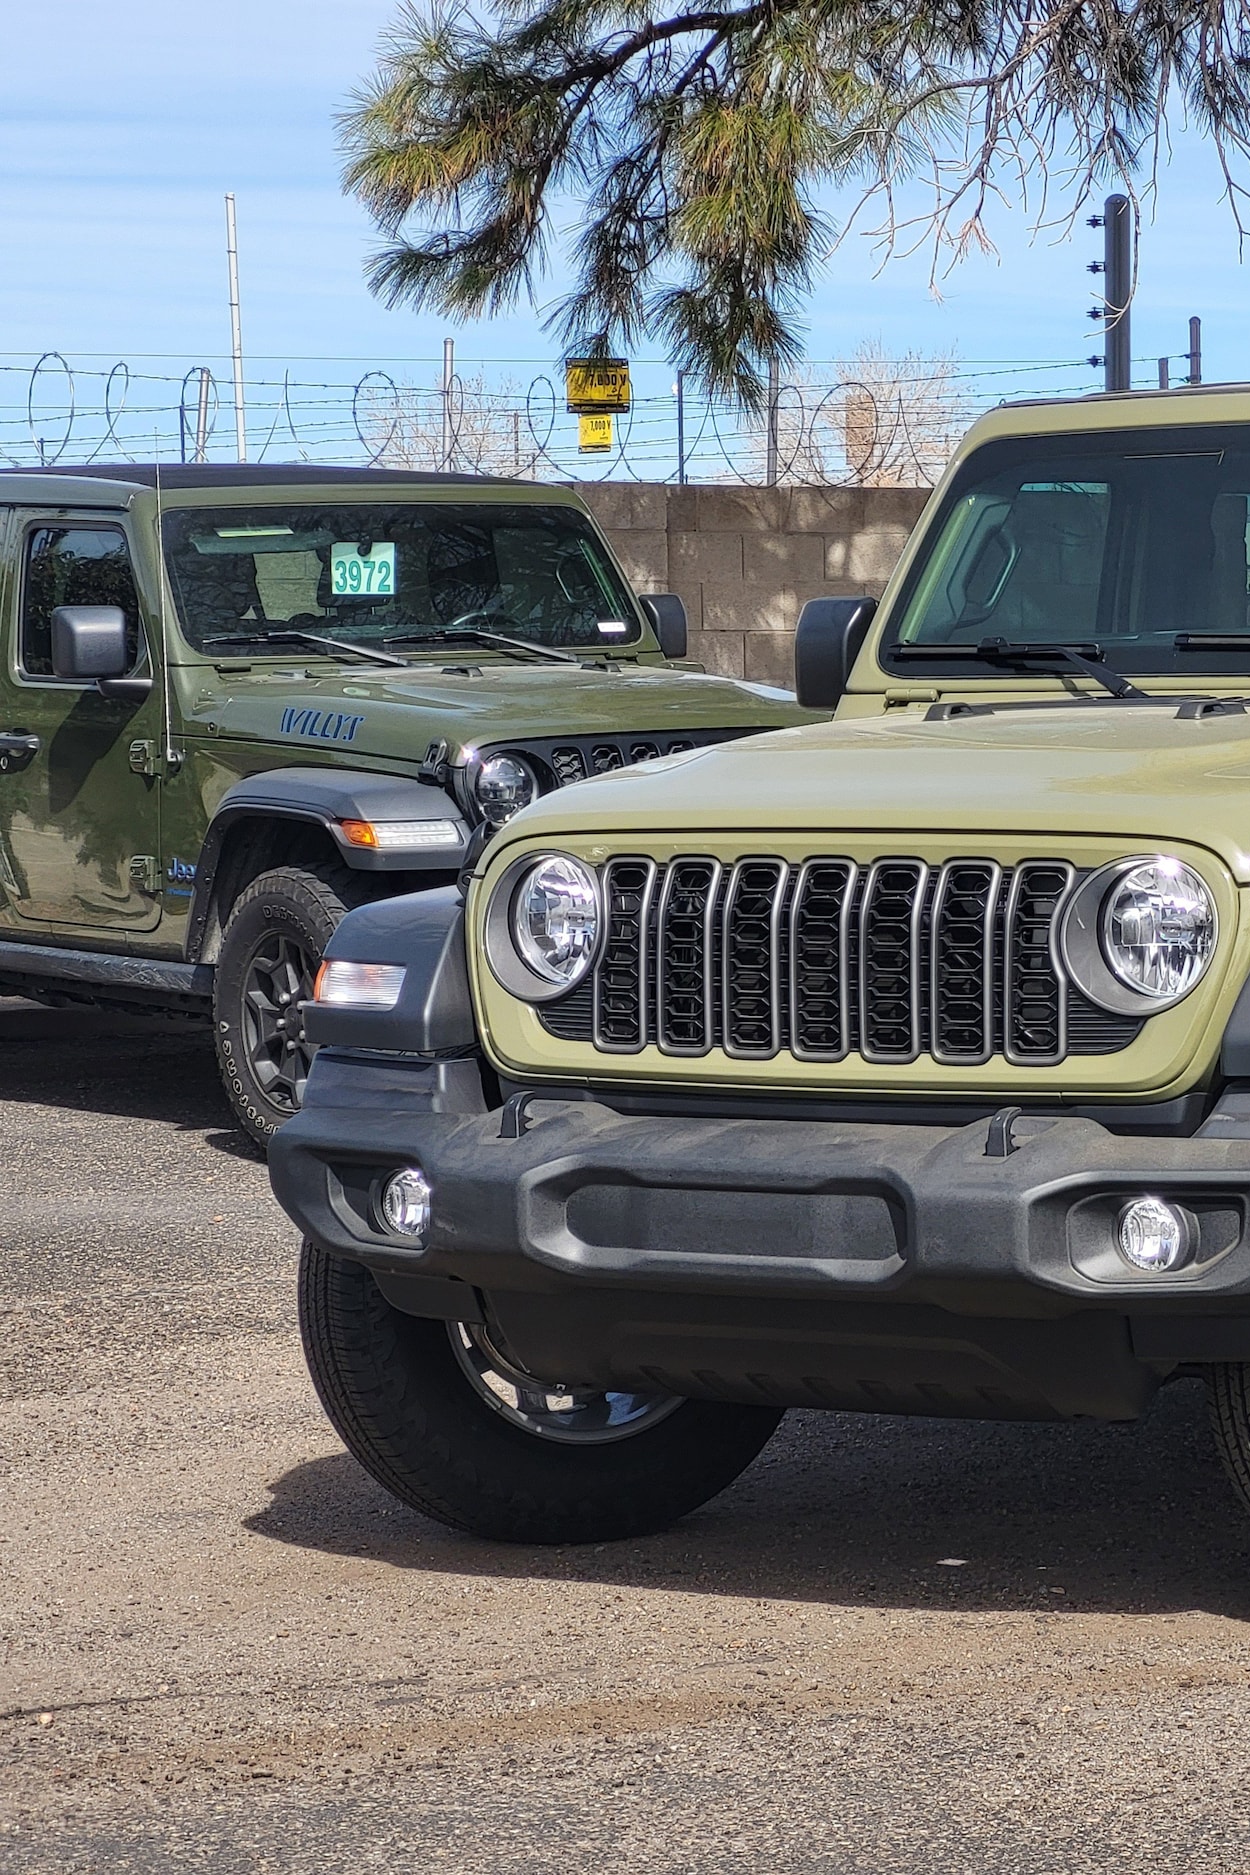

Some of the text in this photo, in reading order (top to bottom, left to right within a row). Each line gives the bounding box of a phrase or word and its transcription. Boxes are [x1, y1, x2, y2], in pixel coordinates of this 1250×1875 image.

[334, 560, 391, 593] 3972
[280, 707, 366, 741] WILLYS
[166, 857, 197, 880] Jee
